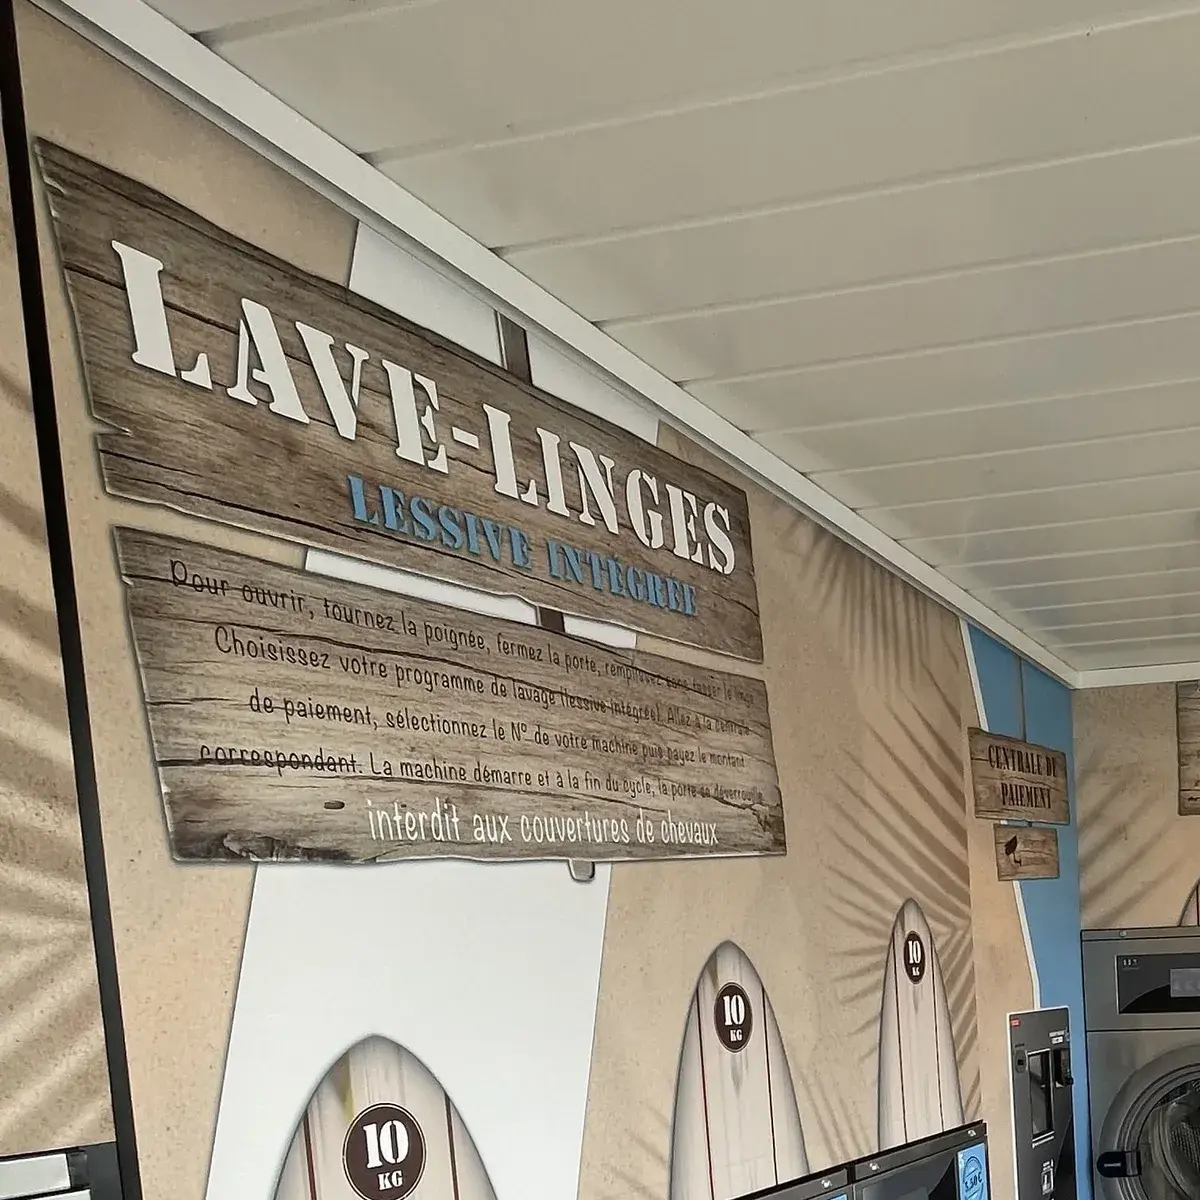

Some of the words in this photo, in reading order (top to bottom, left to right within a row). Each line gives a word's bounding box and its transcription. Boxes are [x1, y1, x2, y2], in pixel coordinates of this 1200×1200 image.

[111, 241, 736, 576] LAVE-LINGES
[347, 474, 532, 571] LESSIVE
[546, 539, 696, 616] INTÉGRÉE
[170, 559, 229, 596] Pour
[242, 582, 314, 620] ouvrir,
[323, 598, 396, 632] tournez
[401, 610, 418, 637] la
[425, 622, 490, 655] poignée,
[497, 632, 543, 662] fermez
[547, 643, 560, 666] la
[565, 654, 600, 677] porte,
[215, 625, 331, 669] Choisissez
[339, 656, 388, 678] votre
[395, 663, 484, 694] programme
[491, 675, 507, 698] de
[513, 678, 556, 709] lavage
[667, 706, 691, 726] Allez
[250, 687, 274, 713] de
[284, 697, 378, 730] paiement,
[386, 706, 487, 738] sélectionnez
[492, 718, 506, 741] le
[534, 725, 551, 746] de
[554, 732, 588, 750] votre
[592, 735, 638, 756] machine
[642, 743, 663, 761] puis
[698, 745, 707, 763] le
[200, 744, 363, 776] correspondant.
[370, 752, 392, 776] La
[400, 757, 467, 781] machine
[474, 761, 532, 786] démarre
[538, 770, 550, 787] et
[556, 771, 564, 789] à
[568, 769, 579, 790] la
[585, 770, 600, 791] fin
[606, 772, 619, 791] du
[623, 774, 655, 799] cycle,
[658, 777, 668, 796] la
[672, 781, 697, 800] porte
[988, 744, 1043, 776] CENTRALE
[1046, 755, 1057, 777] DE
[1001, 782, 1051, 809] PAIEMENT
[367, 797, 460, 842] interdit
[473, 812, 512, 844] aux
[520, 810, 630, 845] couvertures
[637, 808, 654, 843] de
[661, 808, 719, 845] chevaux
[907, 940, 921, 964] 10
[723, 994, 745, 1026] 10
[730, 1029, 743, 1042] KG
[363, 1120, 409, 1168] 10
[378, 1170, 403, 1190] KG
